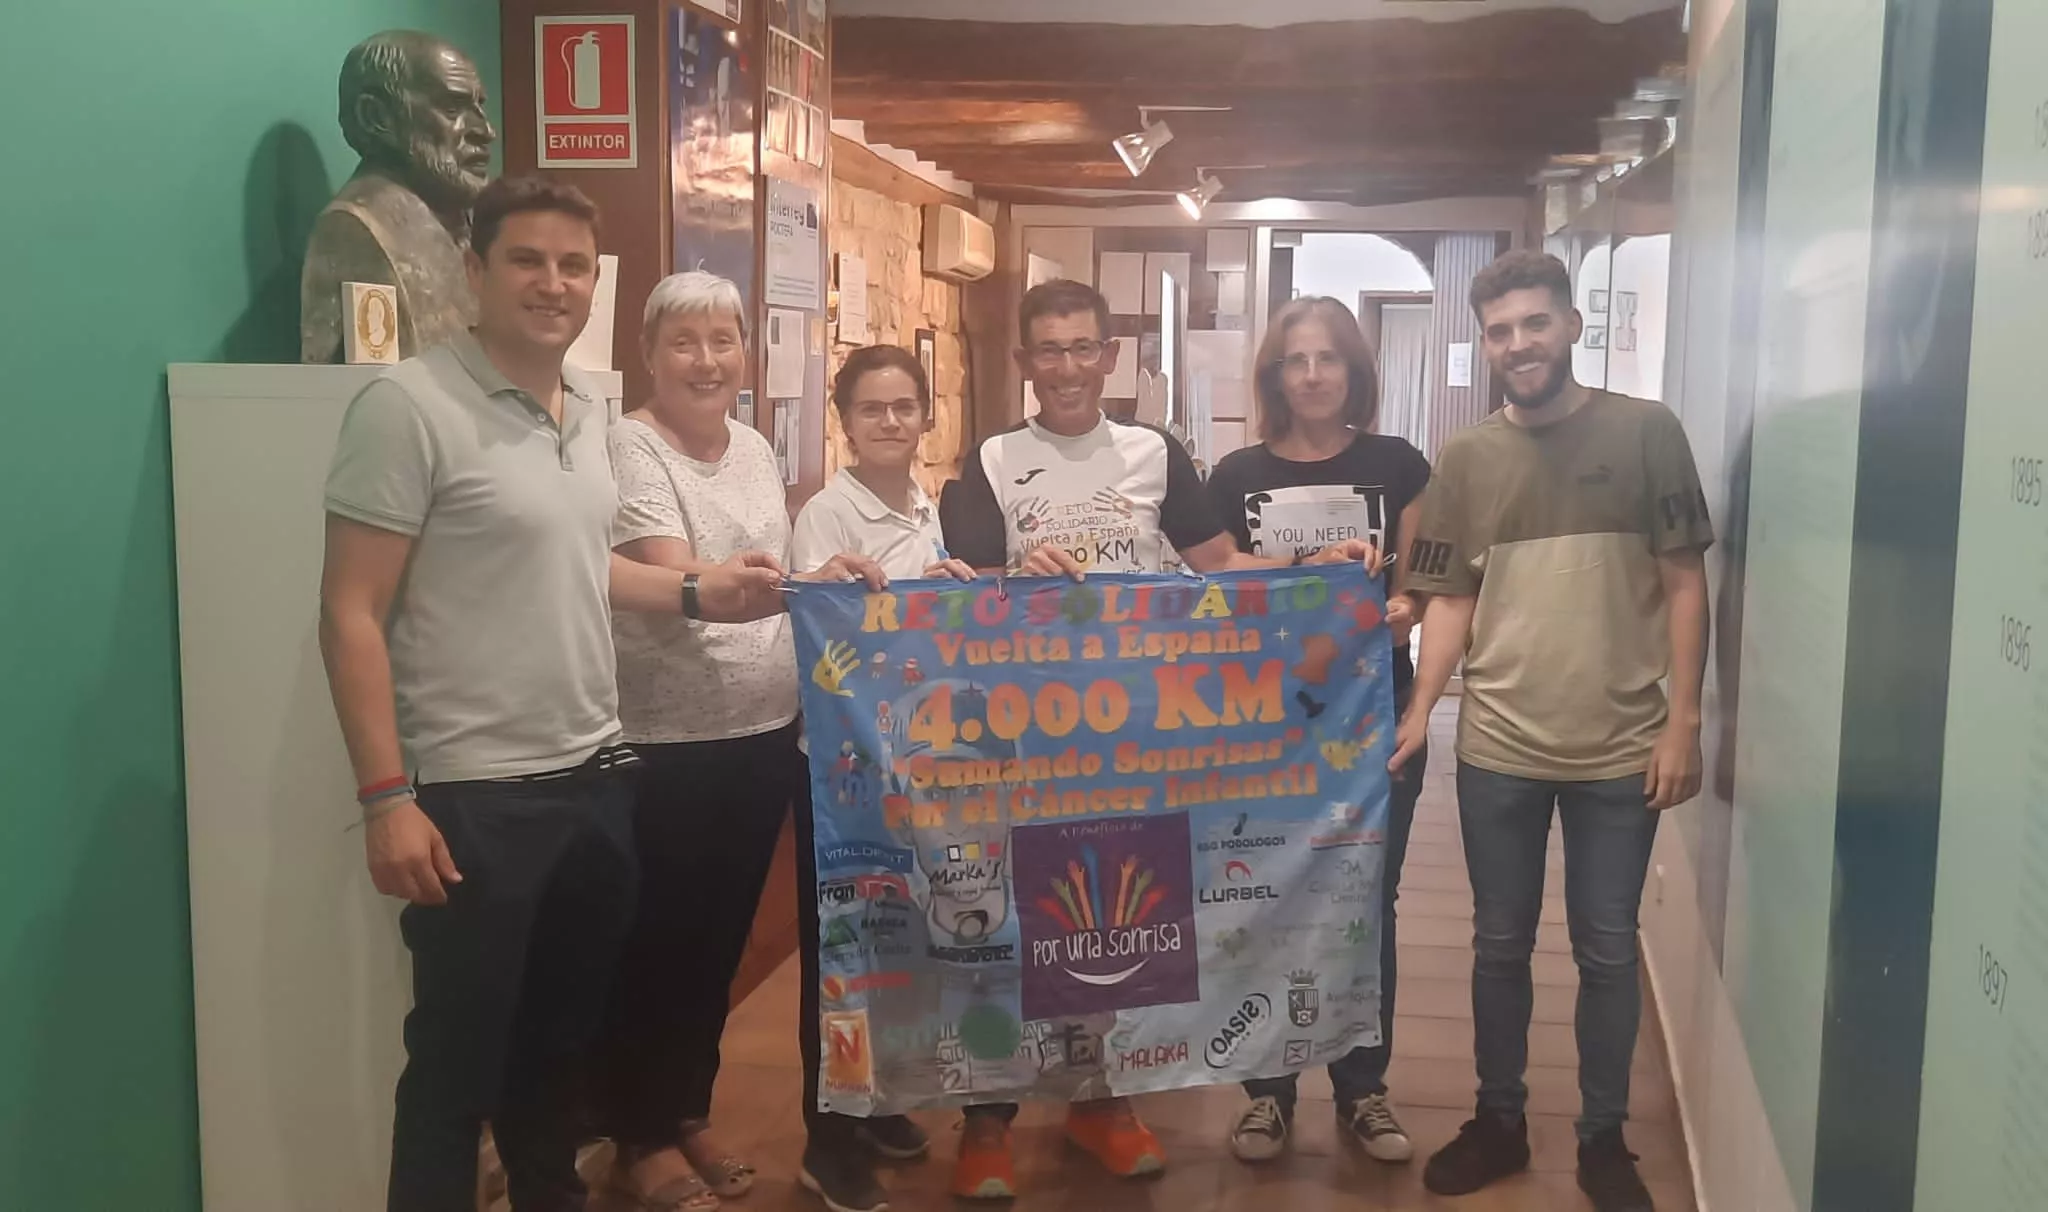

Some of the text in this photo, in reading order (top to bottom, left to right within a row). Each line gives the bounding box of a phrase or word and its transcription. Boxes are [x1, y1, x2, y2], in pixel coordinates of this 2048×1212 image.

[549, 134, 625, 149] EXTINTOR
[2010, 456, 2043, 507] 1895
[1020, 516, 1140, 552] Vuelta a España
[1046, 515, 1108, 533] SOLIDARIO
[1272, 526, 1358, 543] YOU NEED
[1096, 538, 1138, 564] KM
[861, 576, 1328, 633] RETO SOLIDARIO
[932, 620, 1262, 667] Vuelta a España
[2001, 614, 2031, 672] 1896
[908, 659, 1286, 752] 4.000 KM
[883, 763, 1318, 829] Por el Cáncer Infantil
[1199, 885, 1280, 904] LURBEL
[1066, 929, 1102, 963] una
[1106, 922, 1182, 957] sonrisa
[1979, 943, 2007, 1015] 1897
[1211, 1000, 1260, 1055] OASIS
[1119, 1041, 1189, 1072] MALAKA
